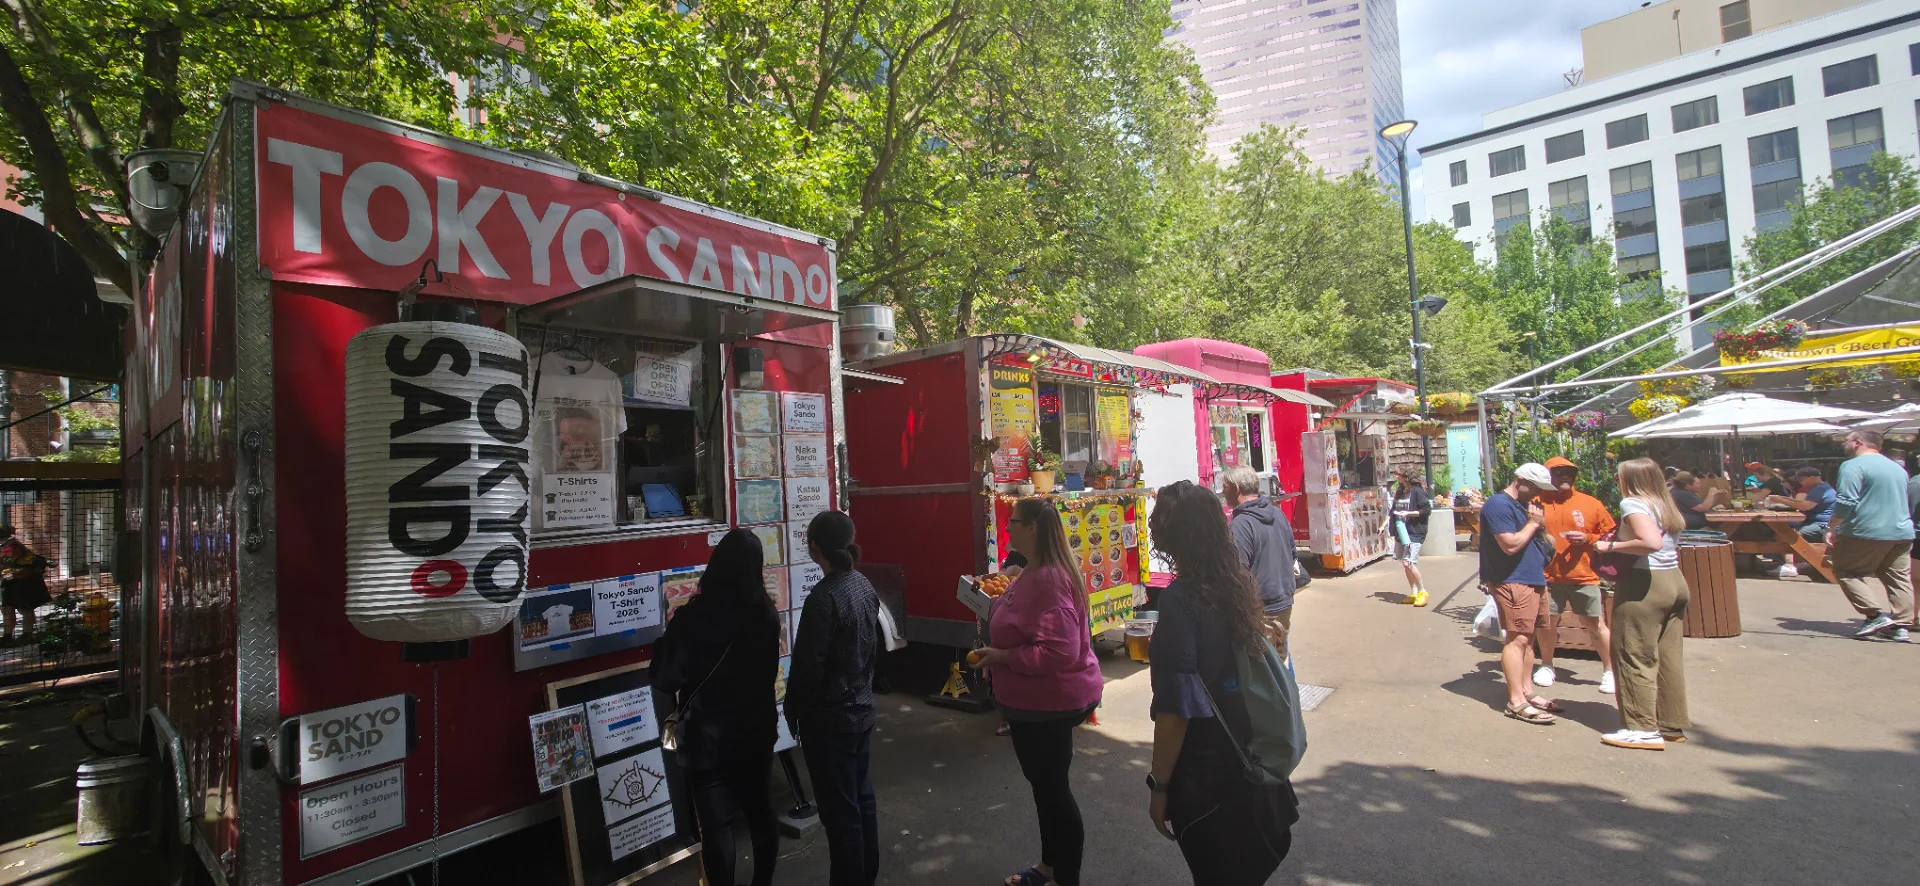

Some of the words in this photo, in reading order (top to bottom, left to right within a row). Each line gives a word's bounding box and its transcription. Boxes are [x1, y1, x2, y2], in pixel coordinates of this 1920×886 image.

[267, 136, 626, 290] TOKYO
[645, 225, 828, 309] SANDO
[1842, 337, 1891, 352] Beer
[652, 362, 677, 374] OPEN
[651, 371, 677, 383] OPEN
[993, 369, 1030, 383] DRINKS
[651, 381, 676, 393] OPEN
[793, 401, 816, 411] Tokyo
[793, 410, 816, 418] Sando
[795, 445, 817, 454] Naka
[385, 334, 472, 598] SANDO
[473, 348, 530, 604] TOKYO
[557, 477, 598, 487] T-Shirts
[796, 485, 820, 494] Katsu
[797, 494, 820, 502] Sando
[804, 574, 821, 583] Tofu
[597, 590, 625, 601] Tokyo
[627, 585, 655, 596] Sando
[610, 597, 645, 610] T-Shirt
[1112, 597, 1132, 612] TACO
[307, 706, 401, 742] TOKYO
[308, 728, 384, 762] SAND
[306, 790, 348, 808] Open
[353, 776, 398, 796] Hours
[308, 805, 353, 823] 11:30am
[362, 790, 399, 807] 3:30pm
[332, 809, 377, 831] Closed
[340, 825, 369, 838] Tuesday
